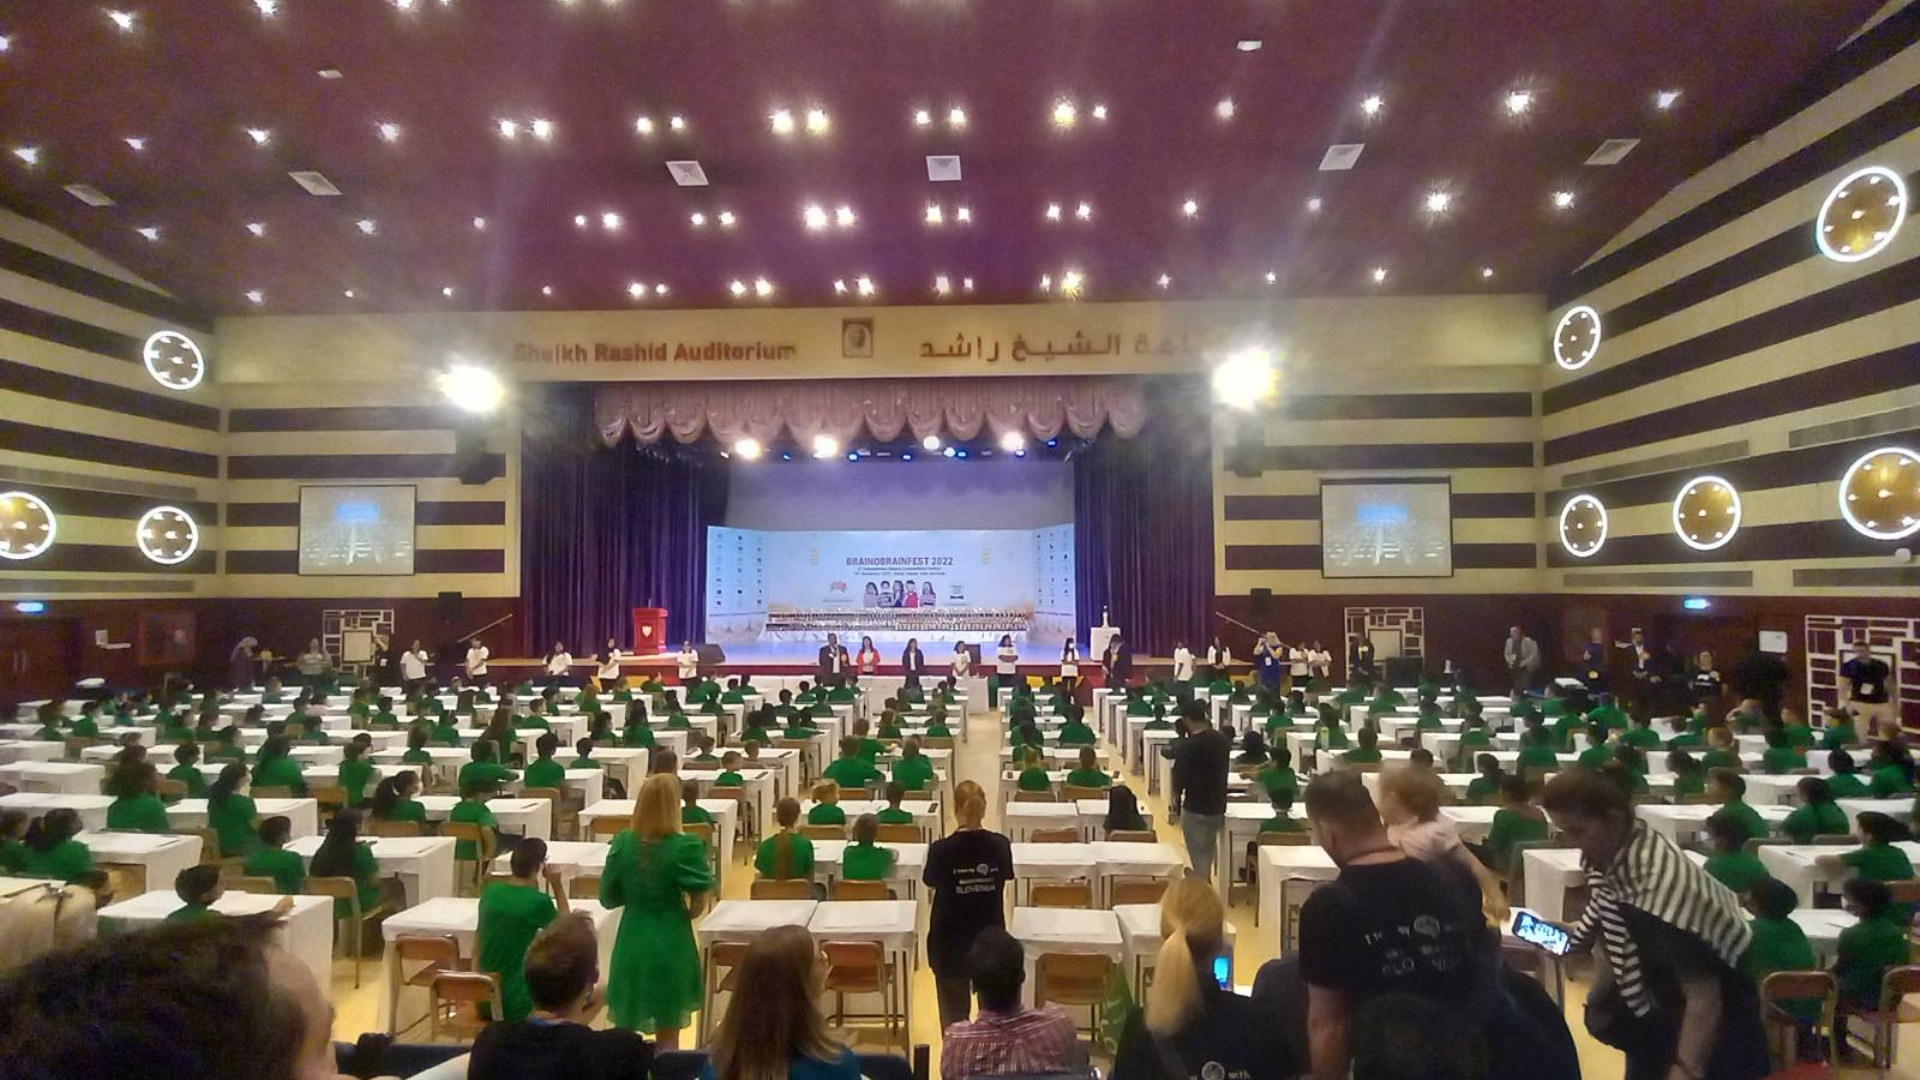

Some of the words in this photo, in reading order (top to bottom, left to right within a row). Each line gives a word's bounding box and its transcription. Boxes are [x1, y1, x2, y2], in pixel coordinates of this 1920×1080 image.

[594, 342, 667, 362] Rashid
[672, 341, 796, 362] Auditorium
[919, 332, 999, 362] راشد
[1011, 330, 1121, 361] الشيخ
[846, 557, 929, 566] BRAINOBRAINFEST
[931, 557, 954, 566] 2022
